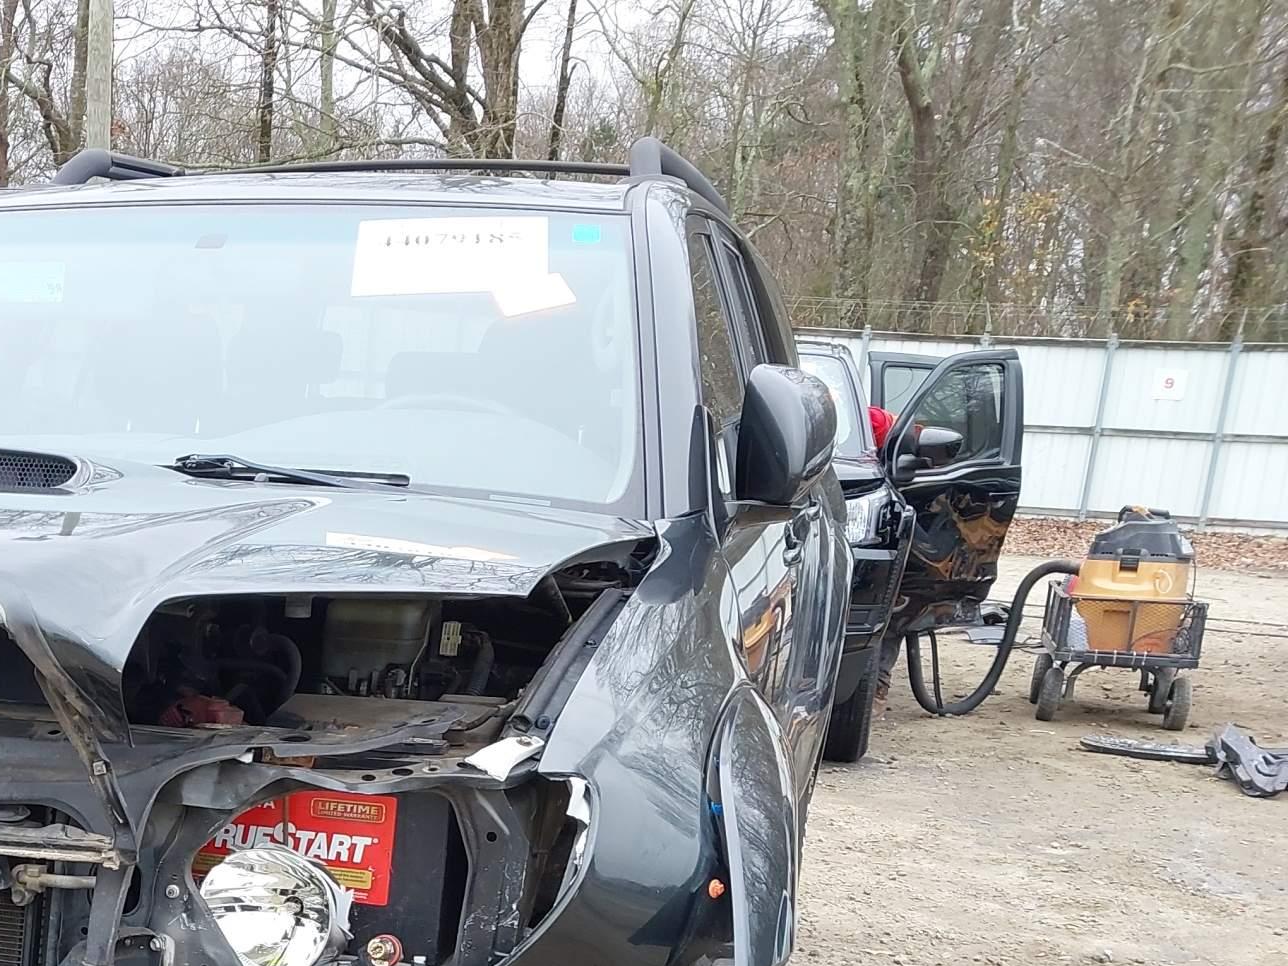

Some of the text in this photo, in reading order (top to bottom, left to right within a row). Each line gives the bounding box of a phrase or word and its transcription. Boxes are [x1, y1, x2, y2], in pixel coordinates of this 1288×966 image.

[1163, 377, 1175, 389] 9
[318, 801, 379, 815] LIFETIME
[214, 821, 373, 864] RUESTART
